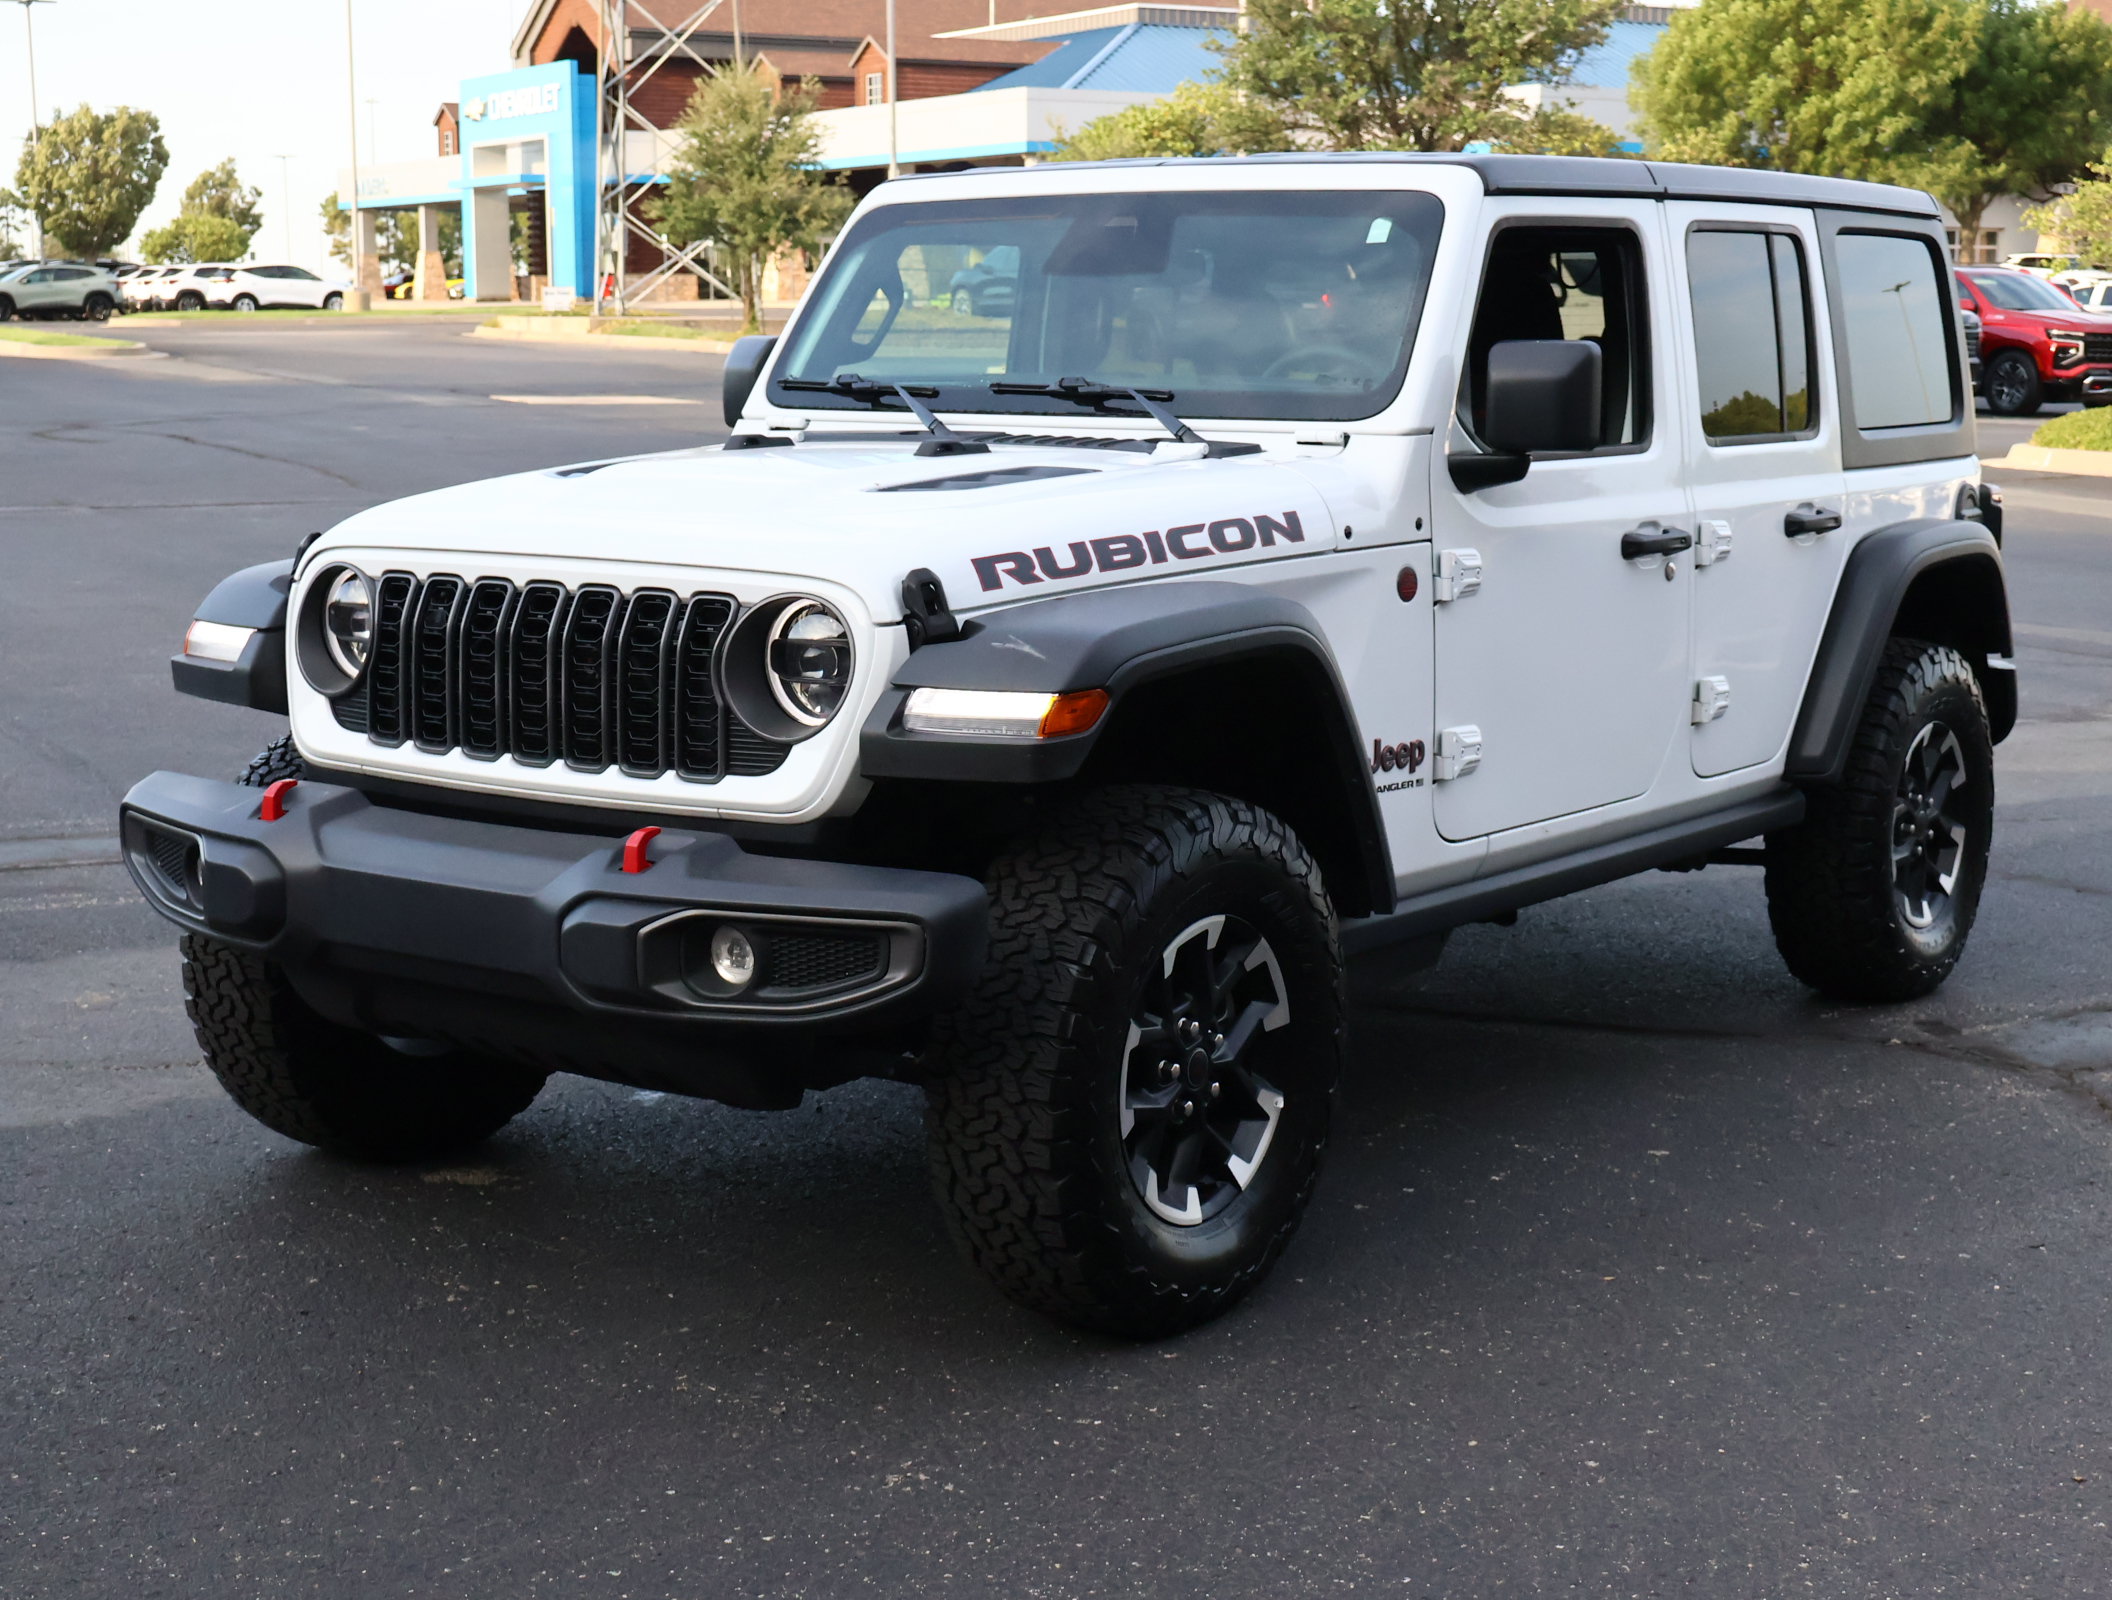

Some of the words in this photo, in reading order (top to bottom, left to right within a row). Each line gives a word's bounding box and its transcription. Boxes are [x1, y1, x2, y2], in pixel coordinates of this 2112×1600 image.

[488, 83, 560, 120] CHEVROLET
[971, 511, 1305, 592] RUBICON
[1370, 738, 1425, 774] Jeep
[1376, 780, 1414, 793] ANGLER
